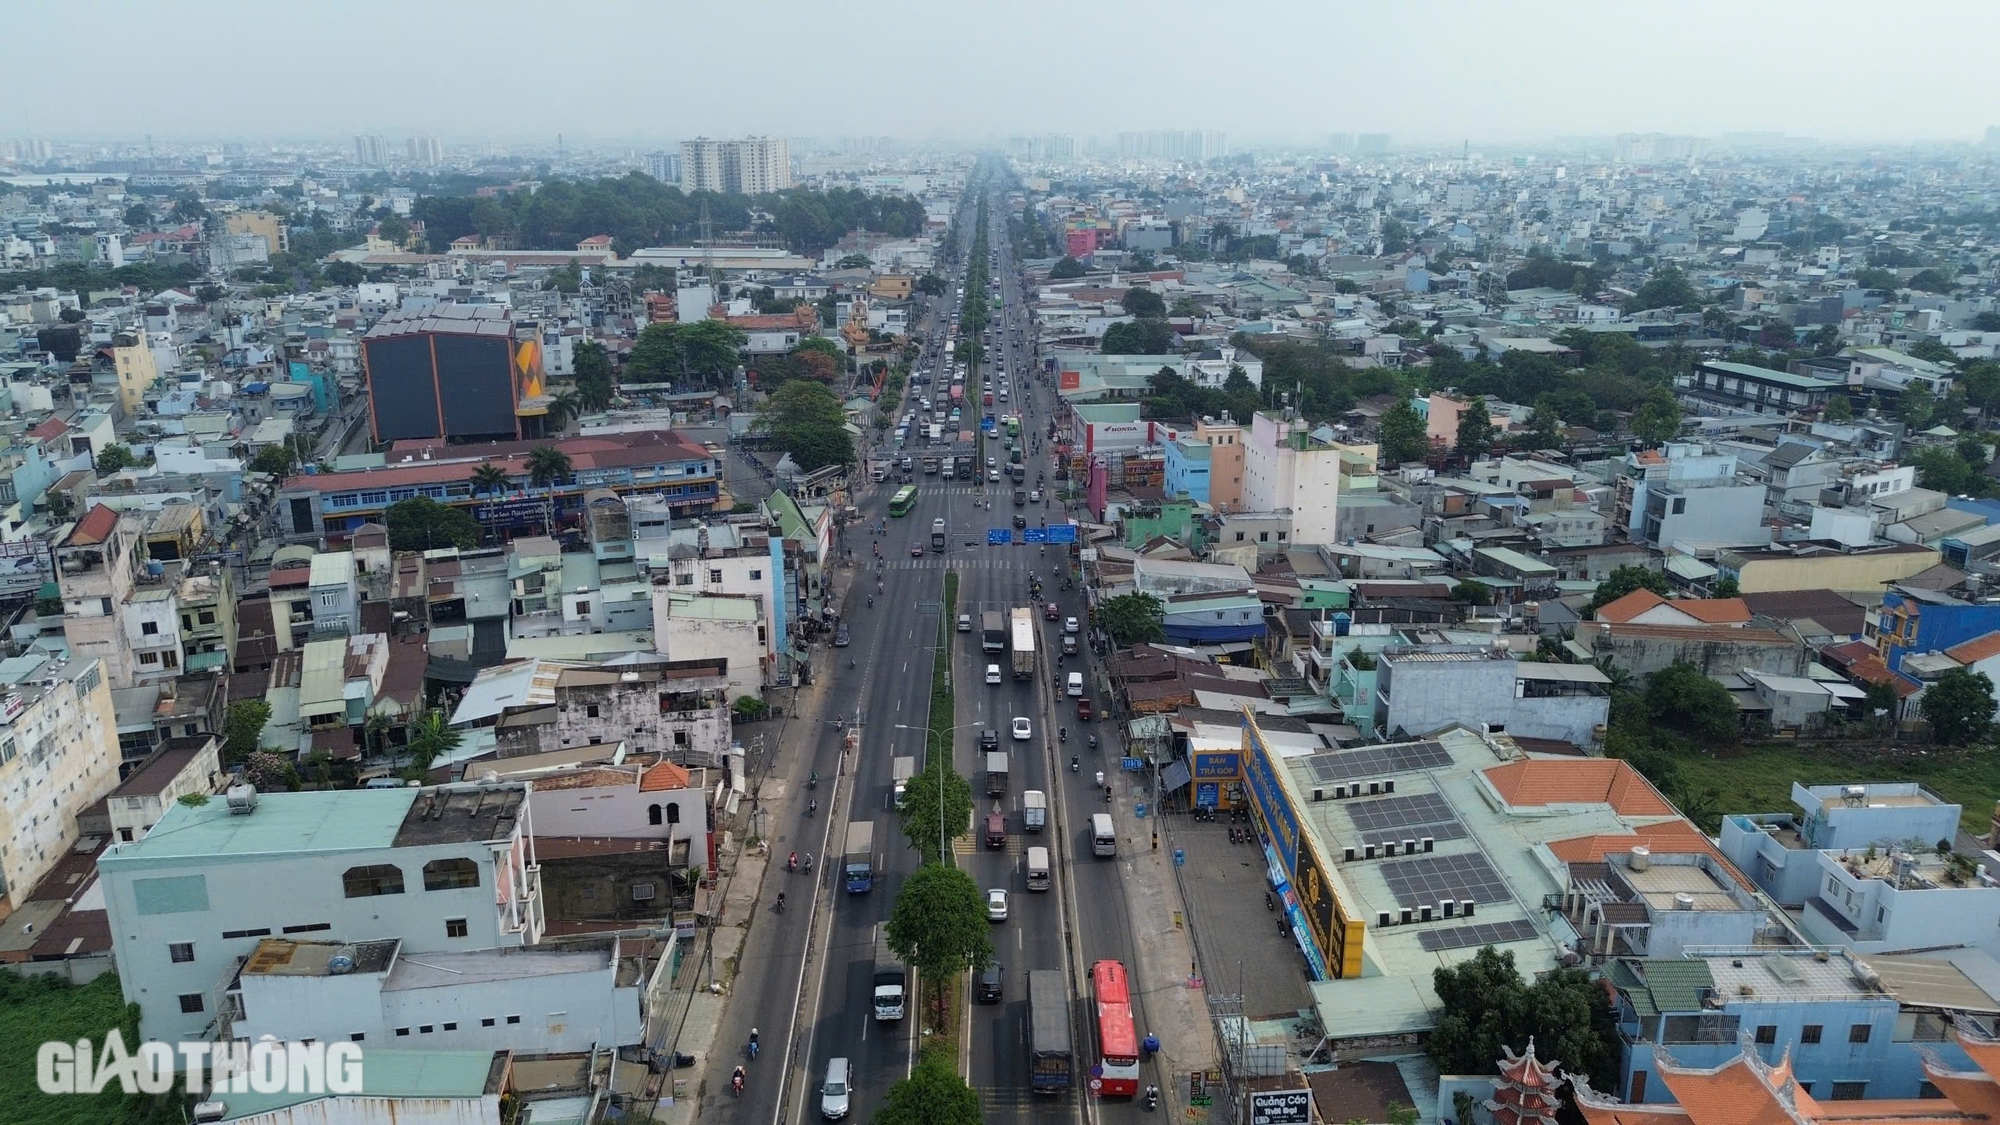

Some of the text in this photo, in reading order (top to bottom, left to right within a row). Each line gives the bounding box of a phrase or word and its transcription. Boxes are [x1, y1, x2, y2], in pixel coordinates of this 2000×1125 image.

[1208, 756, 1226, 764] BÁN
[1217, 766, 1234, 775] GÓP
[1256, 1094, 1307, 1108] Quảng Cáo
